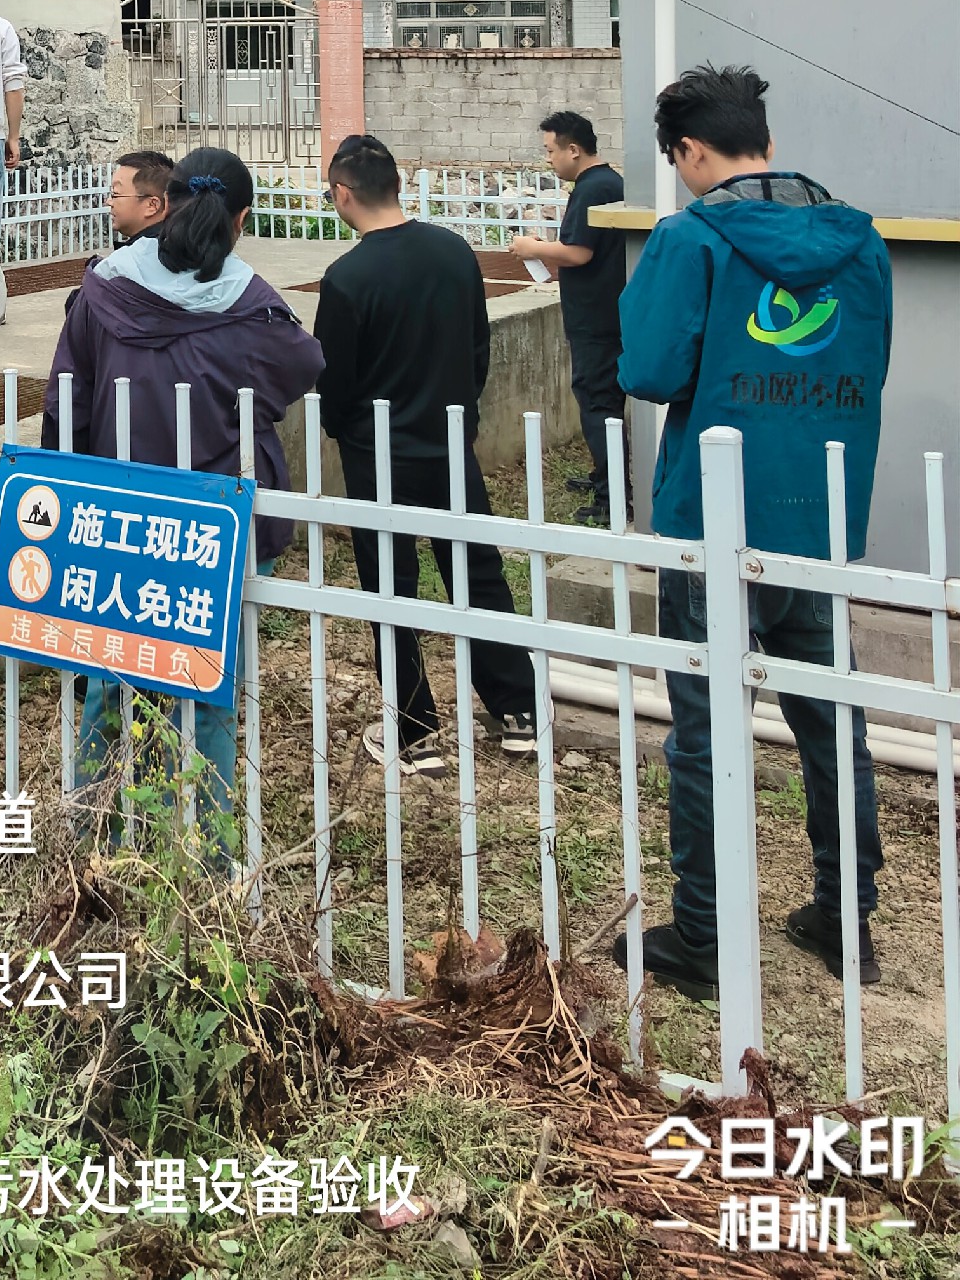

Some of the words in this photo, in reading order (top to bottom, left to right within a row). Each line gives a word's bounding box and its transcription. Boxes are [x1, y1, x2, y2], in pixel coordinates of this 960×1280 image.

[67, 501, 222, 570] 施工现场
[59, 564, 214, 637] 闲人免进
[9, 613, 192, 681] 违者后果自负
